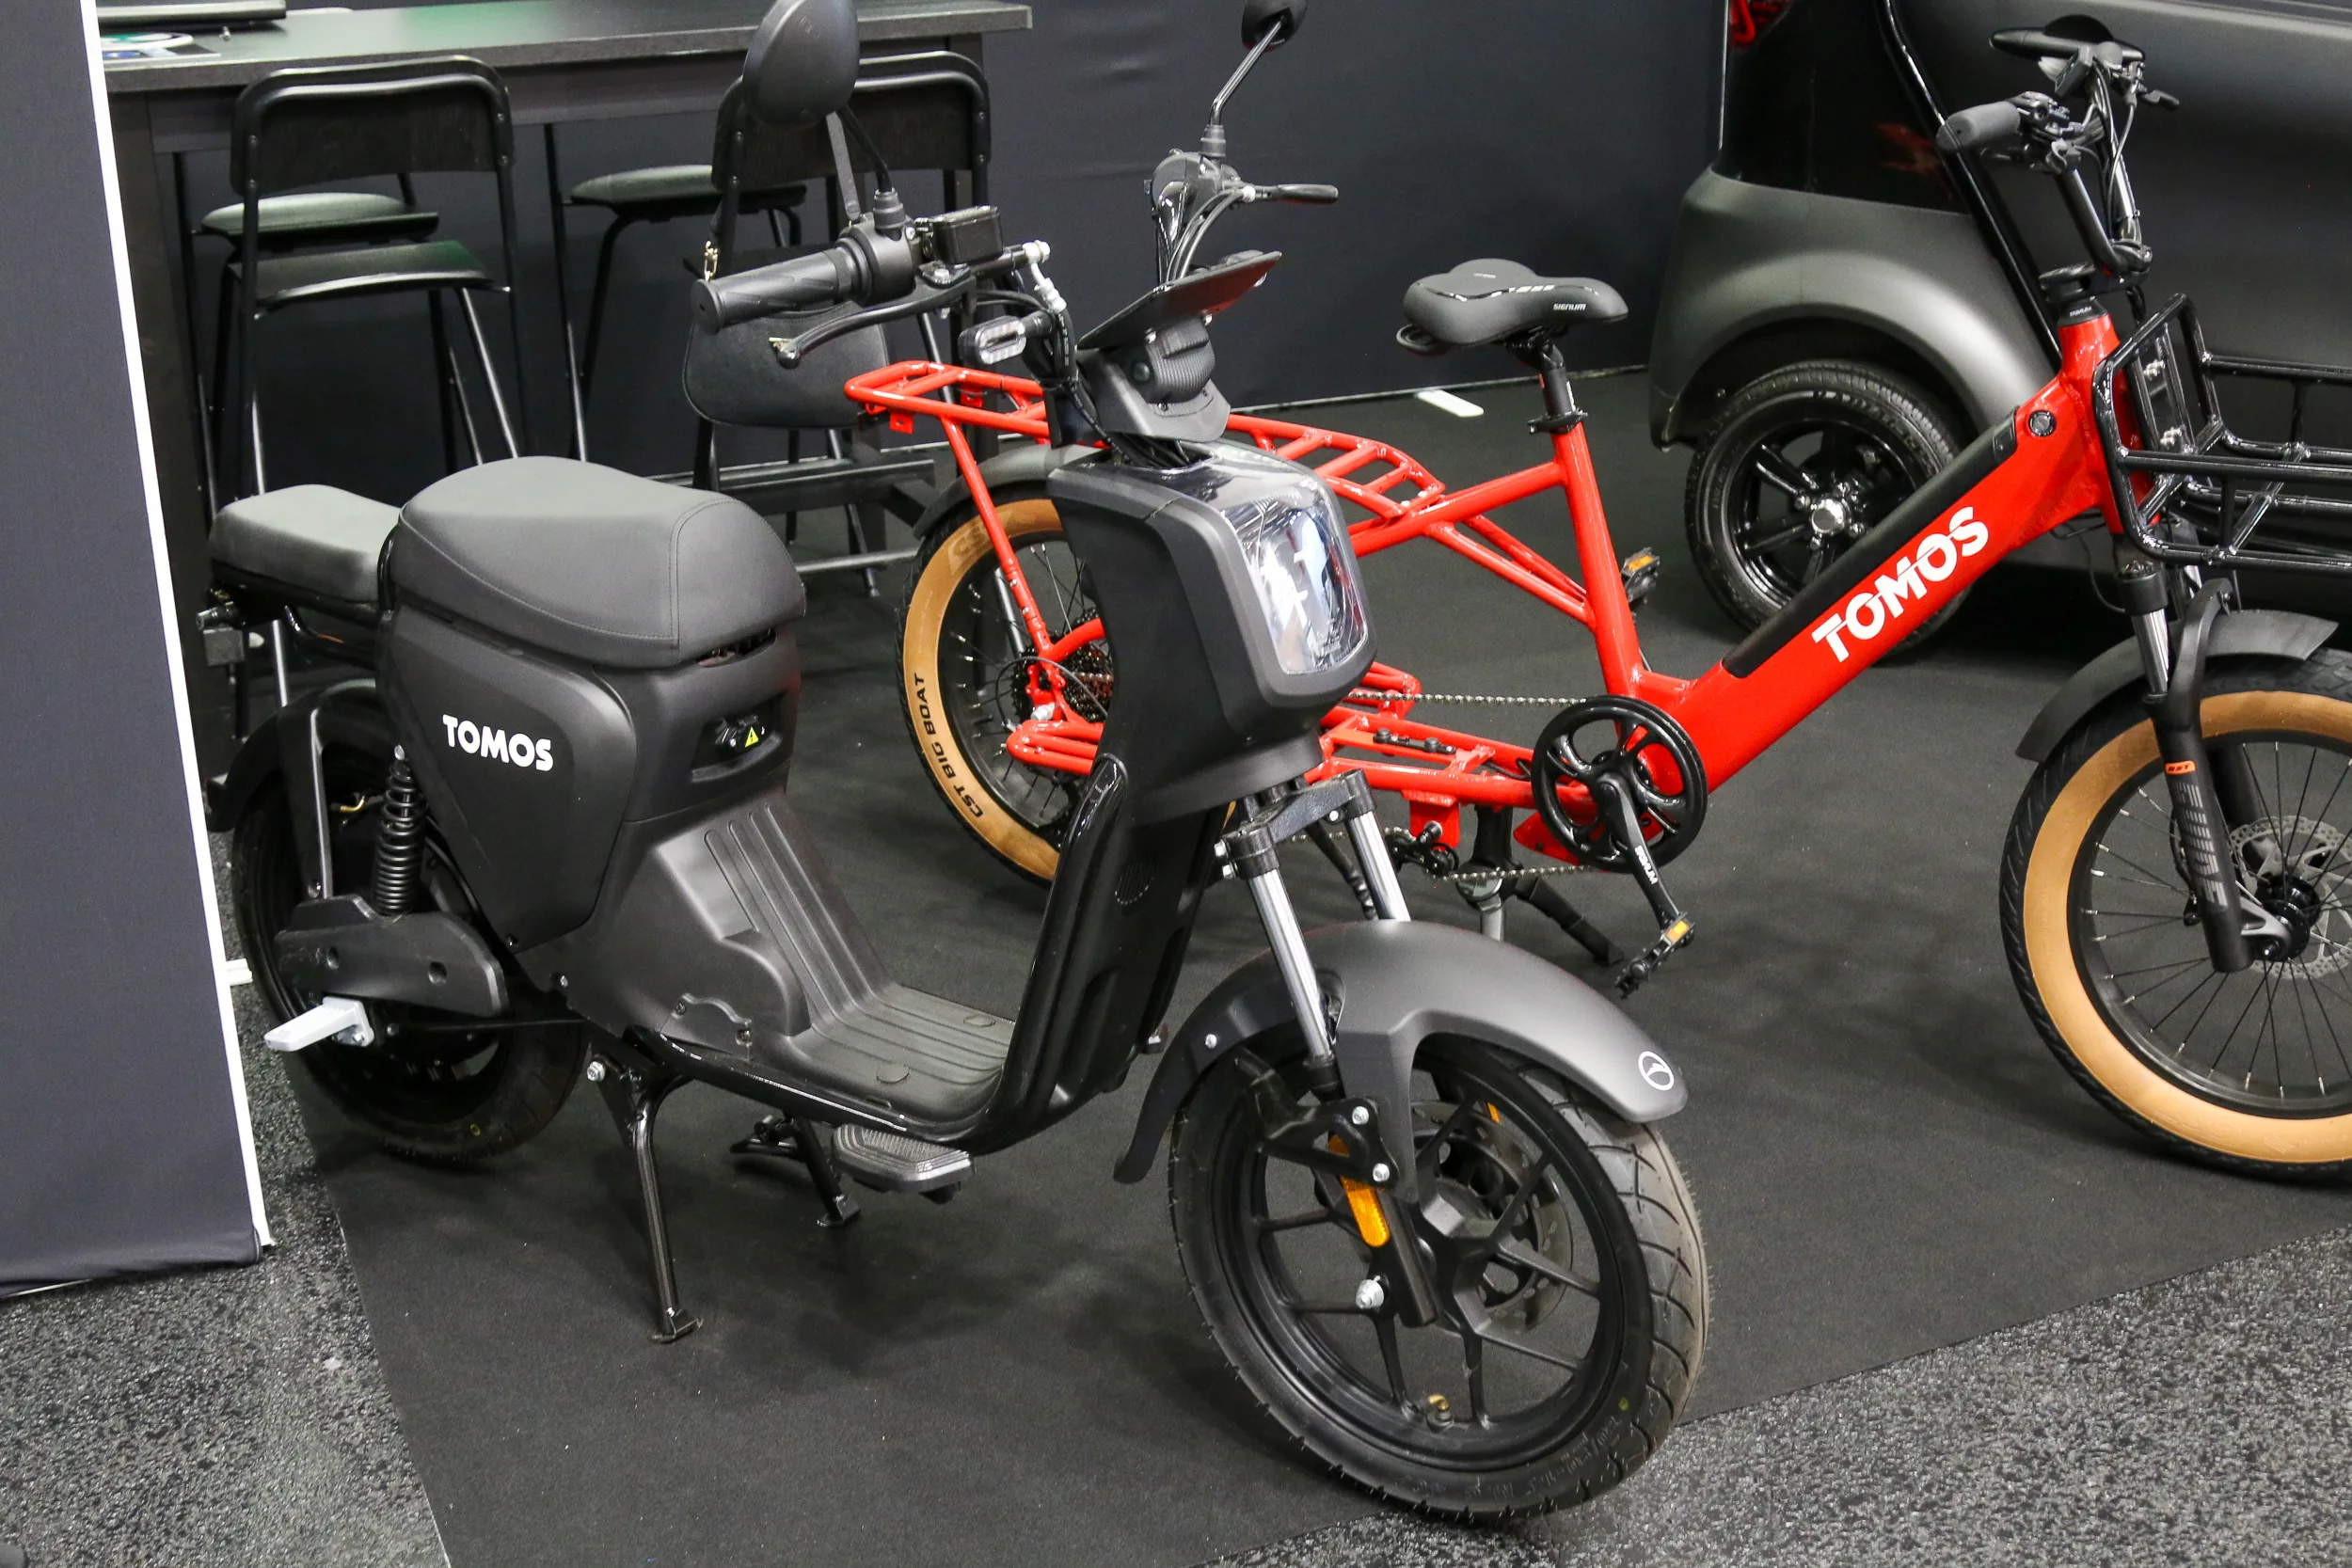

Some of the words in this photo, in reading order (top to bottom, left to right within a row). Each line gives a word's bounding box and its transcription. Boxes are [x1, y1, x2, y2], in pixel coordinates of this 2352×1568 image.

[1553, 303, 1586, 311] SIGNUM
[1811, 506, 1989, 663] TOMOS
[914, 672, 936, 736] BOAT
[442, 714, 554, 771] TOMOS
[931, 741, 956, 779] BIG
[953, 784, 984, 817] CST
